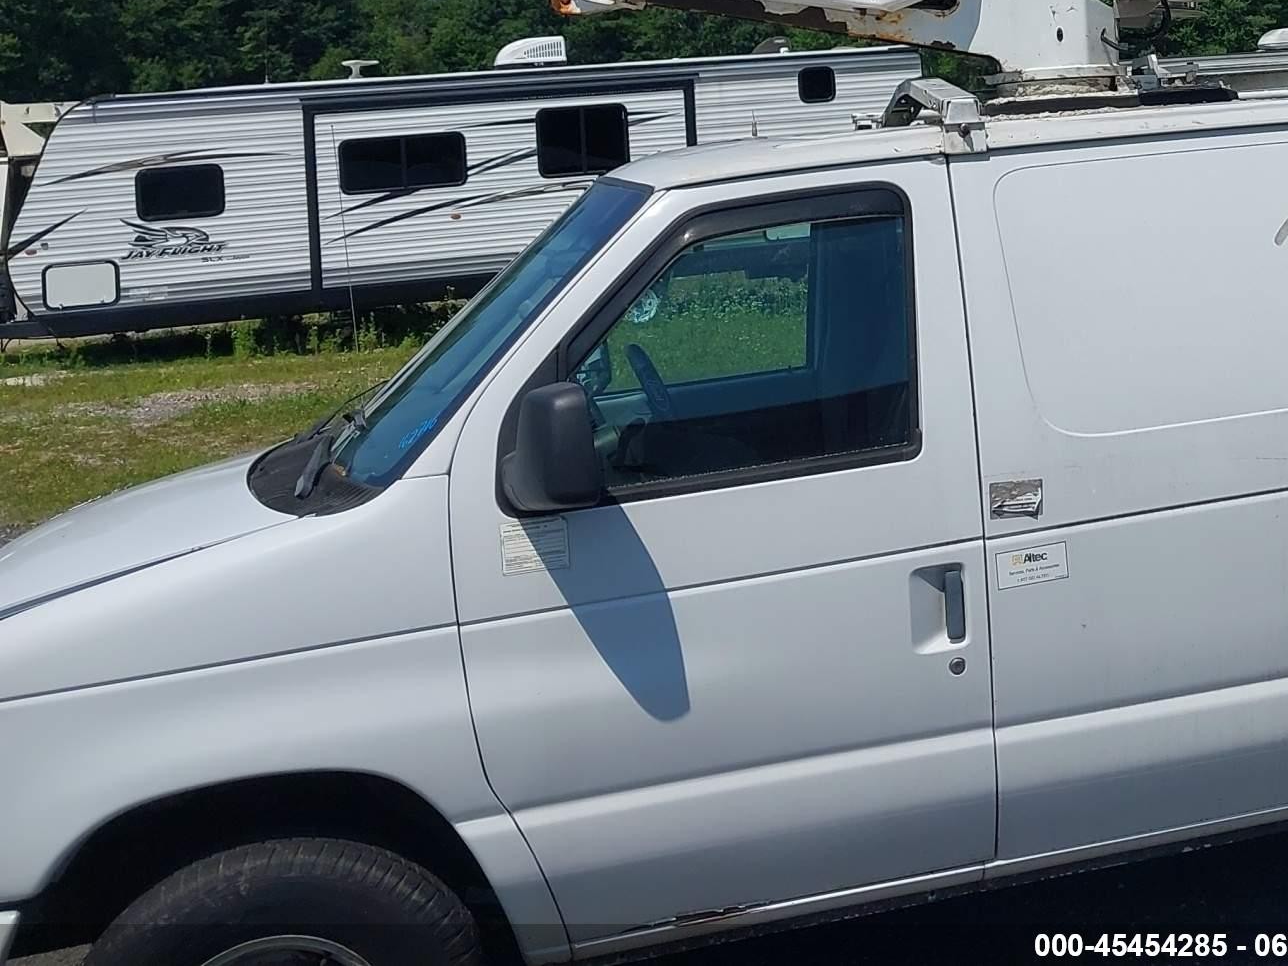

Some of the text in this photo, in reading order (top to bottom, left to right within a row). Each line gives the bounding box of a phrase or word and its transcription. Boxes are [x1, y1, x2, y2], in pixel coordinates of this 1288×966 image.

[121, 242, 229, 260] JAY FLIGHT
[1024, 552, 1048, 564] Altec
